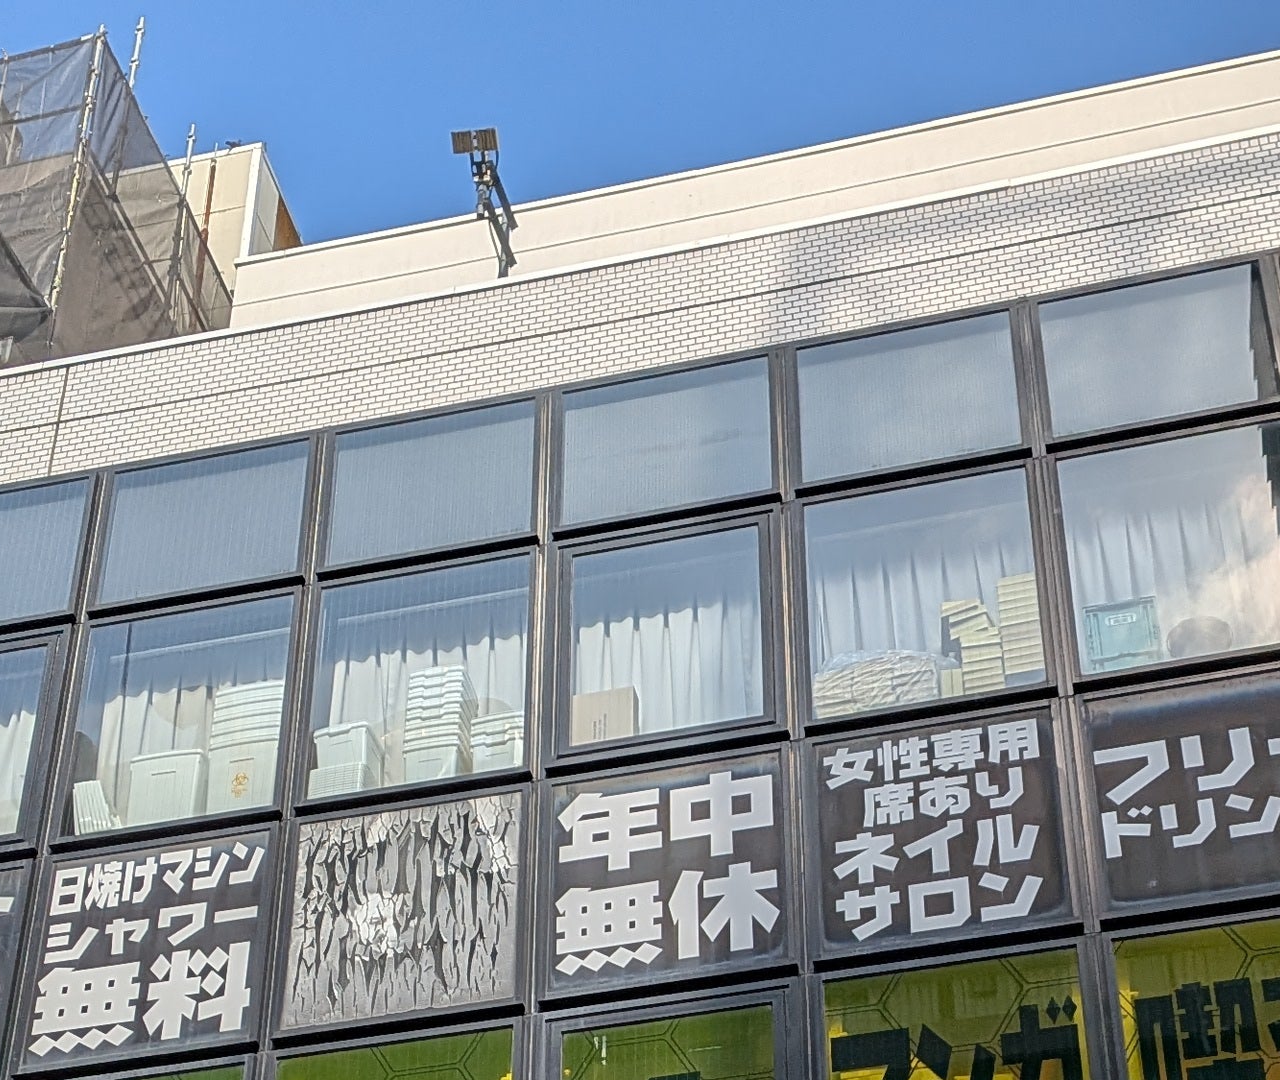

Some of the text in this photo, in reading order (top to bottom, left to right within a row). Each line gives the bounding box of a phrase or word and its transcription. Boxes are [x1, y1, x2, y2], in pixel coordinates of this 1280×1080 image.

[823, 717, 1040, 790] 女性専用
[556, 770, 774, 871] 年中
[863, 766, 1025, 828] 席あり
[49, 842, 265, 917] 日焼けマシン
[833, 812, 1041, 885] ネイル
[44, 903, 259, 964] シャワー
[555, 861, 781, 976] 無休
[835, 874, 1043, 941] サロン
[28, 941, 250, 1057] 無料
